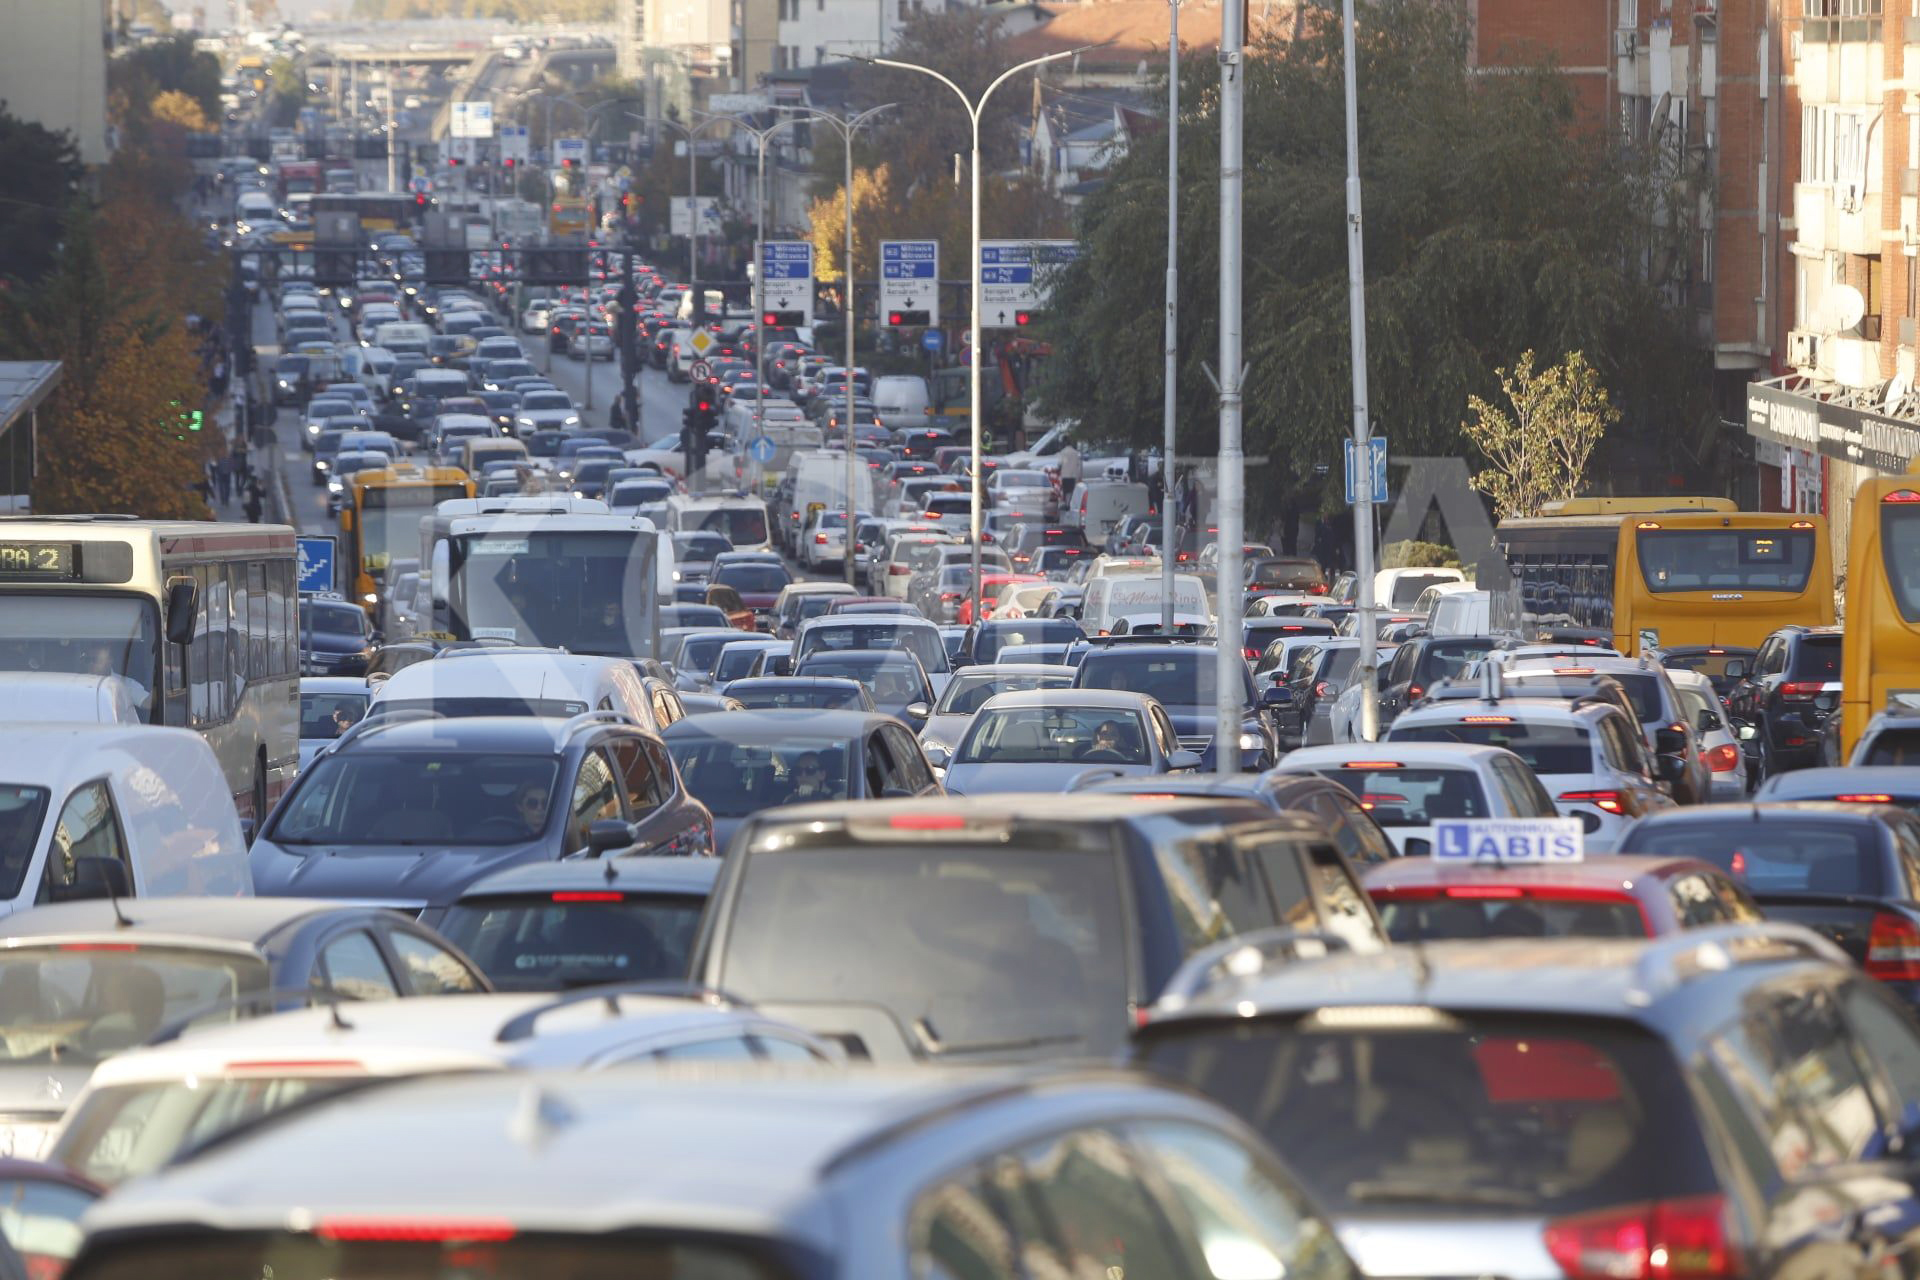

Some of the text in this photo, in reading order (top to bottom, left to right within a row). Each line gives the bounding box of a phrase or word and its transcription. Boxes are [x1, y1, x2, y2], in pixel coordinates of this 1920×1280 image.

[38, 548, 59, 569] 2
[1444, 827, 1463, 854] L
[1477, 836, 1576, 857] ABIS
